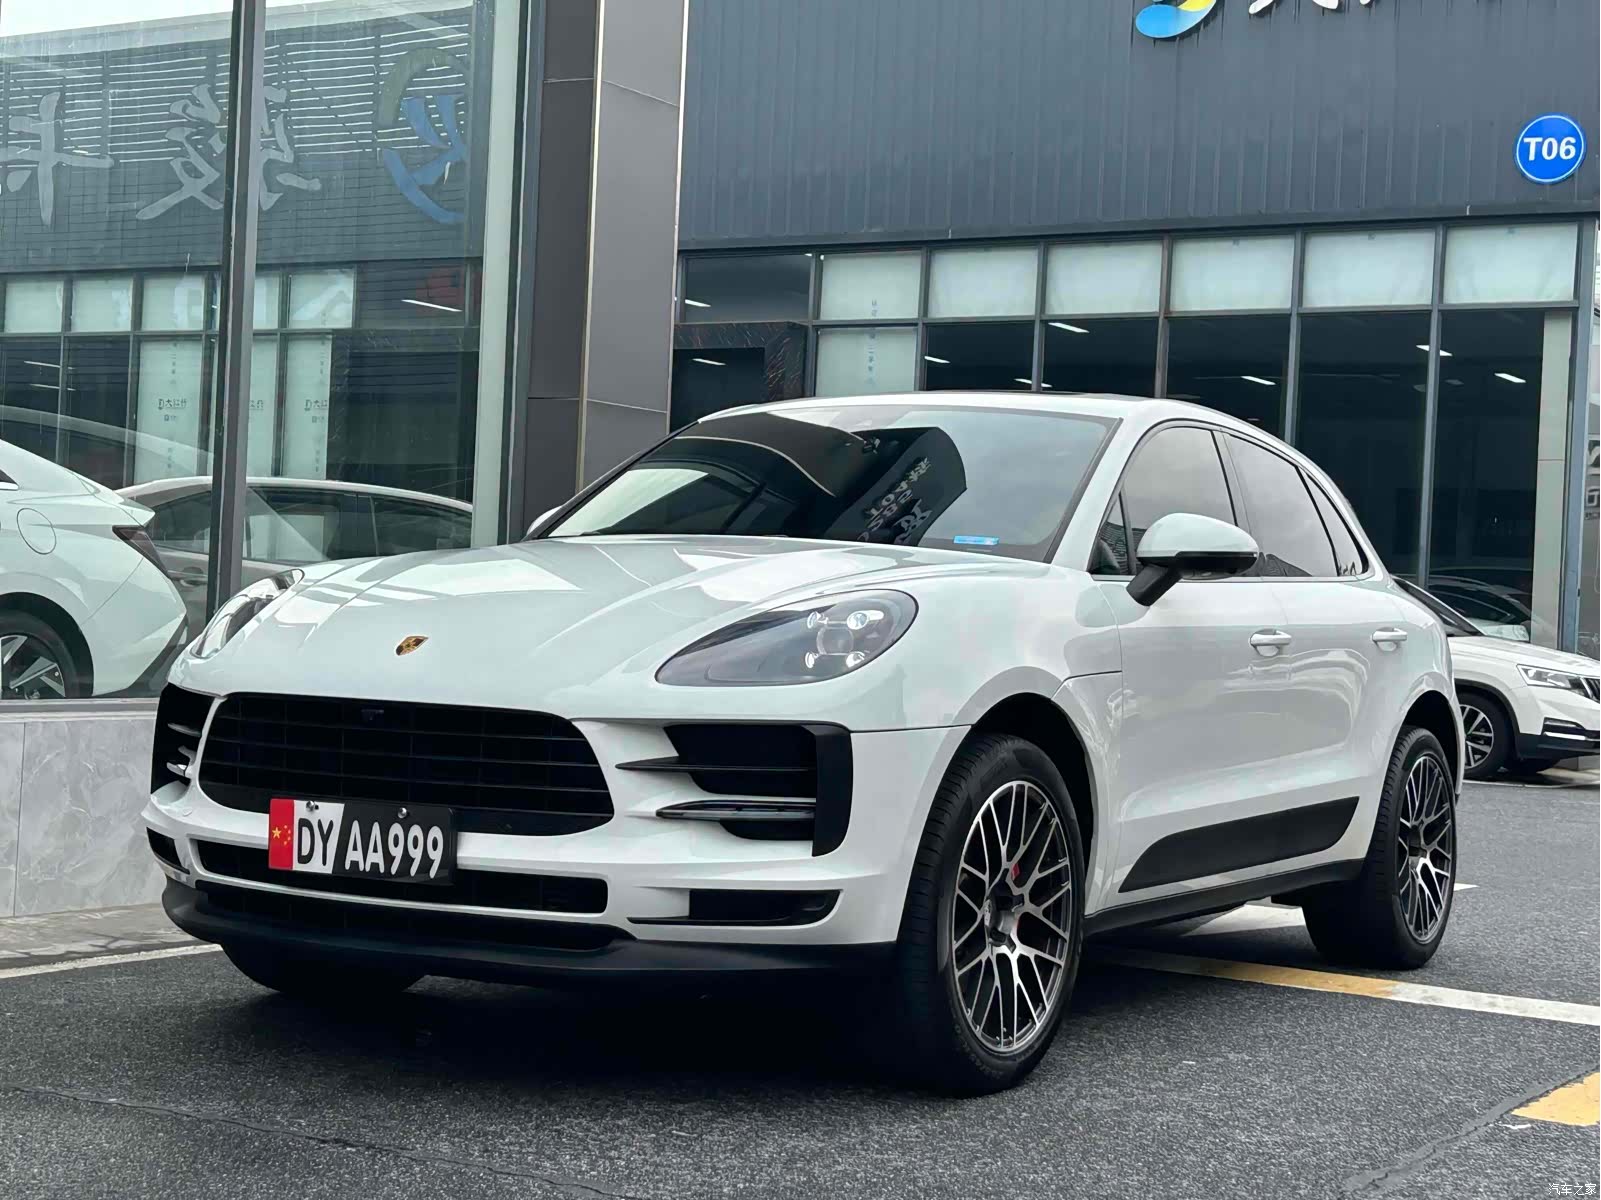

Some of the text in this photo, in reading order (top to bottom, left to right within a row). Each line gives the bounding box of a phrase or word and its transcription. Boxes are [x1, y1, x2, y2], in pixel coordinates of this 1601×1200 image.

[1523, 137, 1576, 161] T06
[298, 818, 444, 879] DY AA999
